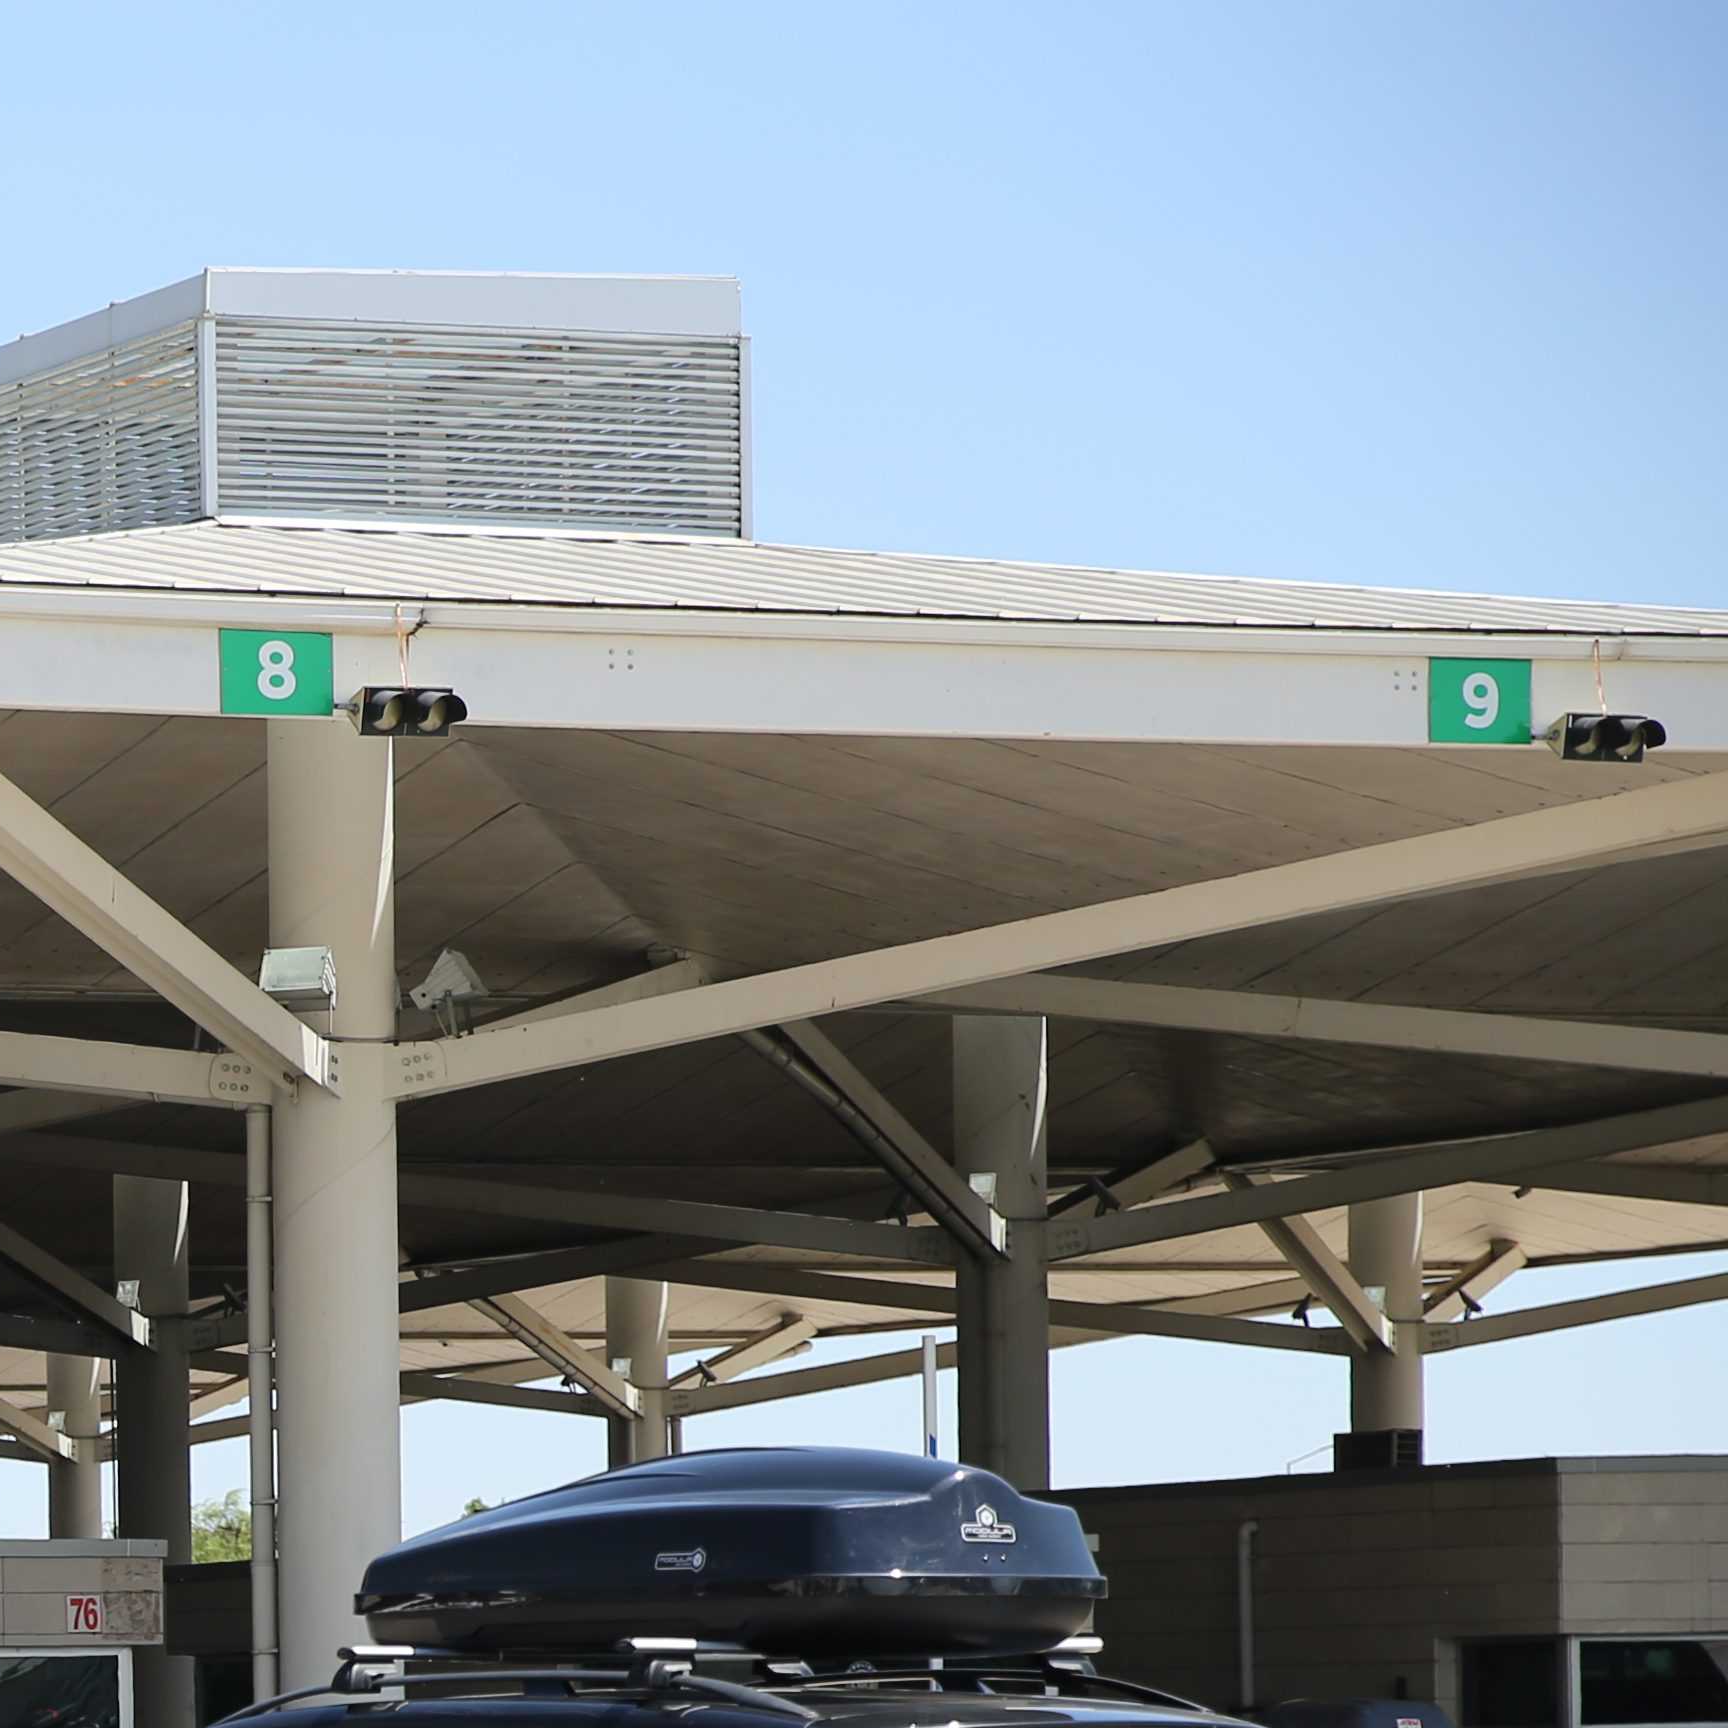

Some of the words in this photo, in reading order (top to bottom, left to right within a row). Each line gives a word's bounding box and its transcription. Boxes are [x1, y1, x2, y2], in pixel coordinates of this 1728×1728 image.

[257, 640, 297, 700] 8
[1462, 672, 1499, 728] 9
[69, 1597, 98, 1630] 76
